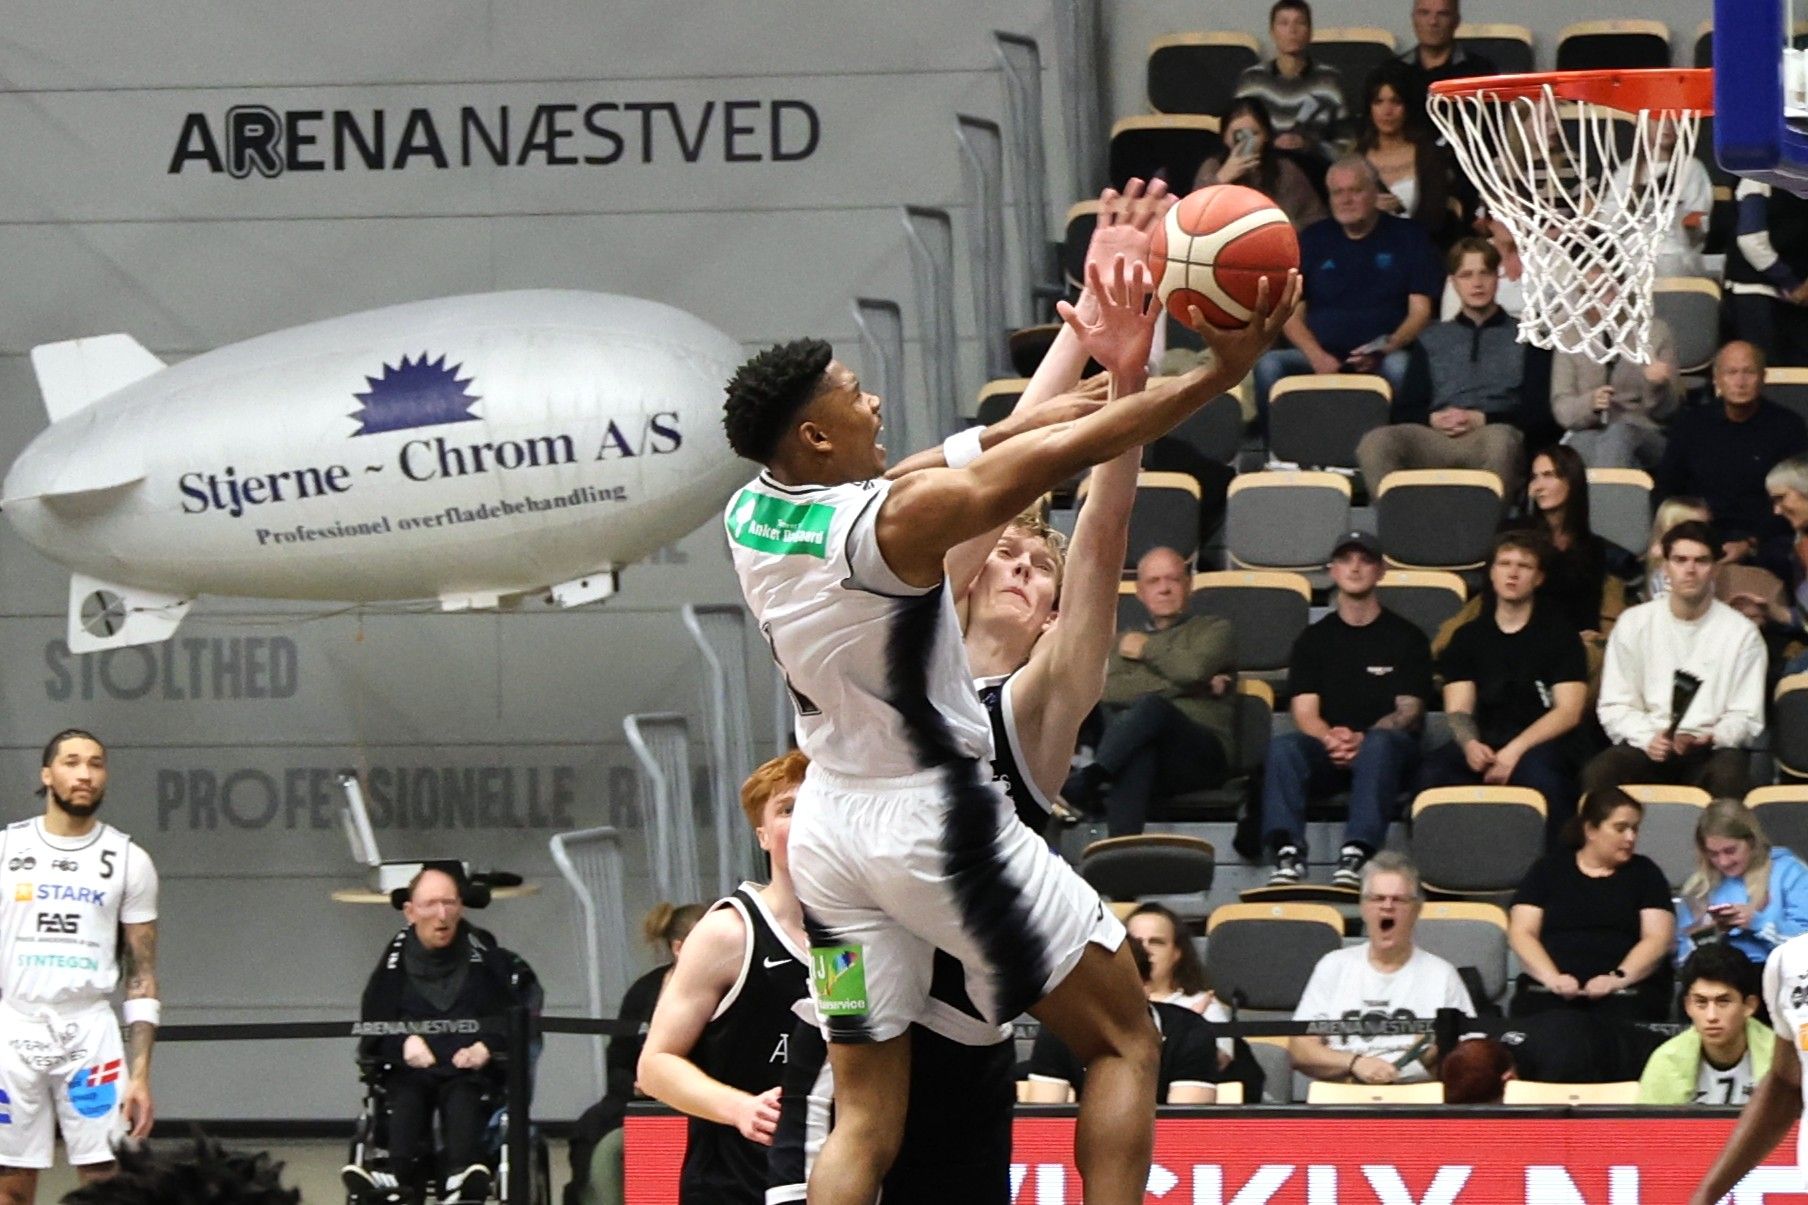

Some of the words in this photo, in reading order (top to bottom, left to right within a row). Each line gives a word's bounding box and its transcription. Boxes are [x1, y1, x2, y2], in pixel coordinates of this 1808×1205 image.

[179, 465, 354, 518] Stjerne
[399, 436, 578, 482] Chrom
[594, 411, 683, 462] A/S
[255, 516, 391, 546] Professionel
[397, 484, 628, 532] overfladebehandling
[99, 849, 118, 879] 5
[37, 883, 107, 907] STARK
[17, 953, 99, 972] SYNTEGON
[1716, 1077, 1736, 1105] 7
